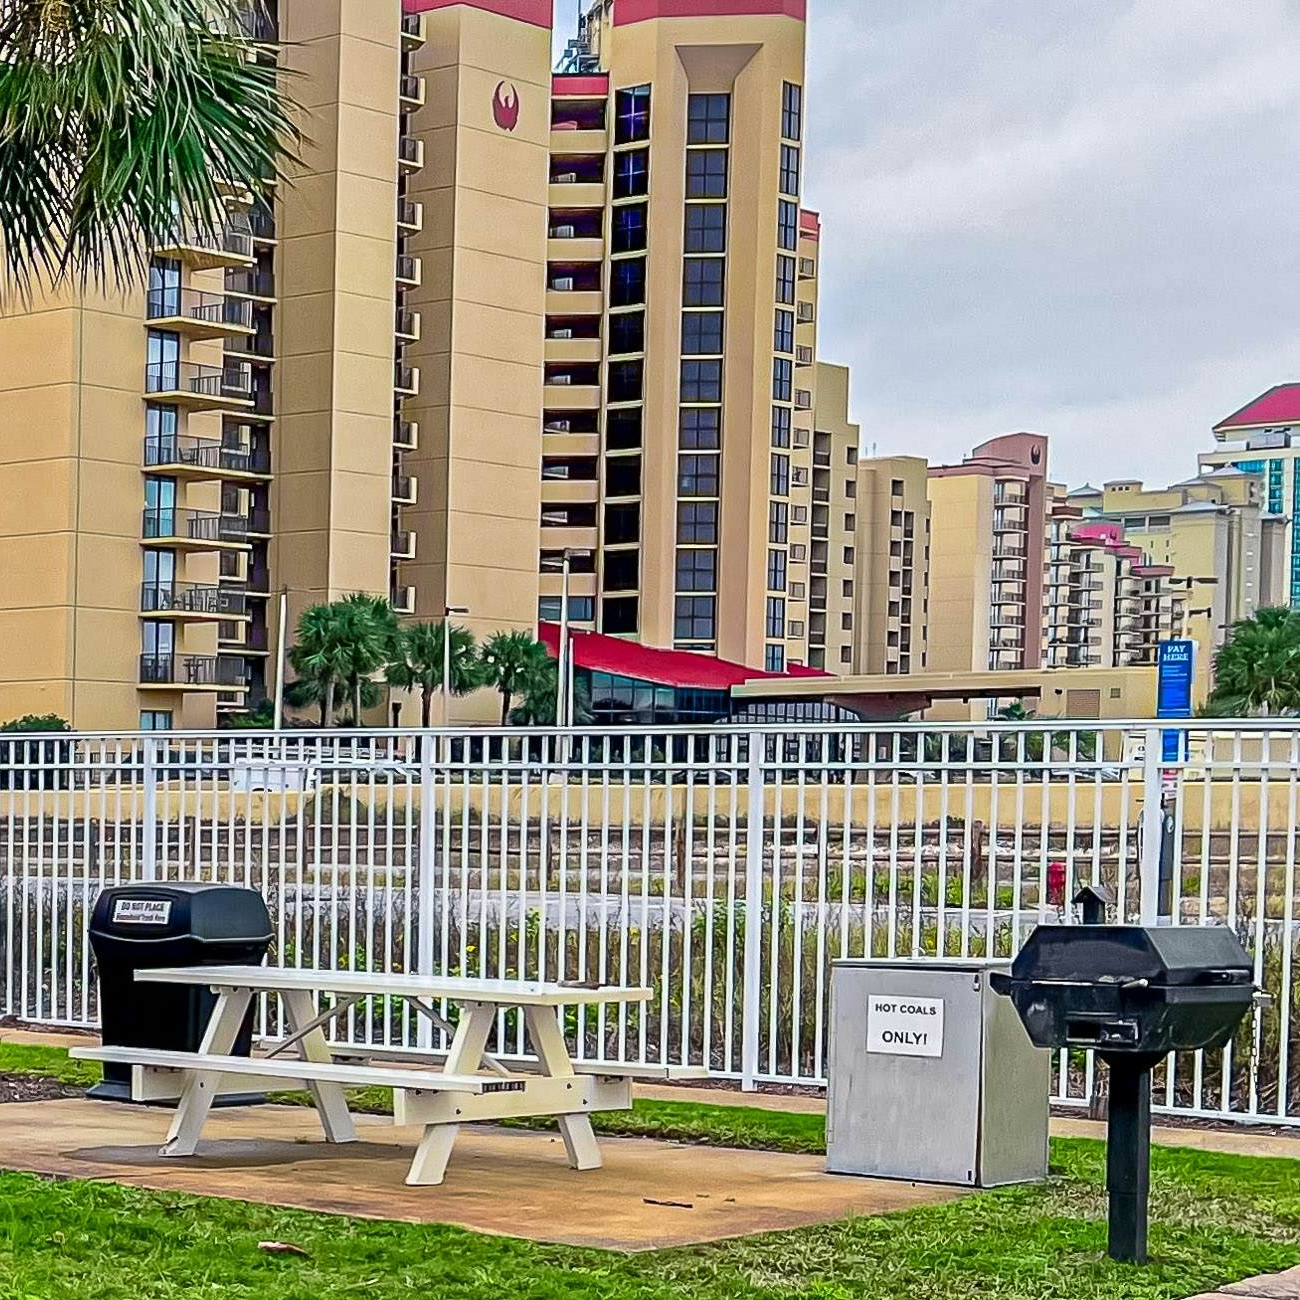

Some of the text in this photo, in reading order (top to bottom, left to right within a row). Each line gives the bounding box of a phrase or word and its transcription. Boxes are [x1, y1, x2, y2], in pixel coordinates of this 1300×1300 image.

[144, 902, 165, 912] PLACE
[875, 1002, 937, 1016] HOT COALS
[881, 1030, 928, 1046] ONLY!
